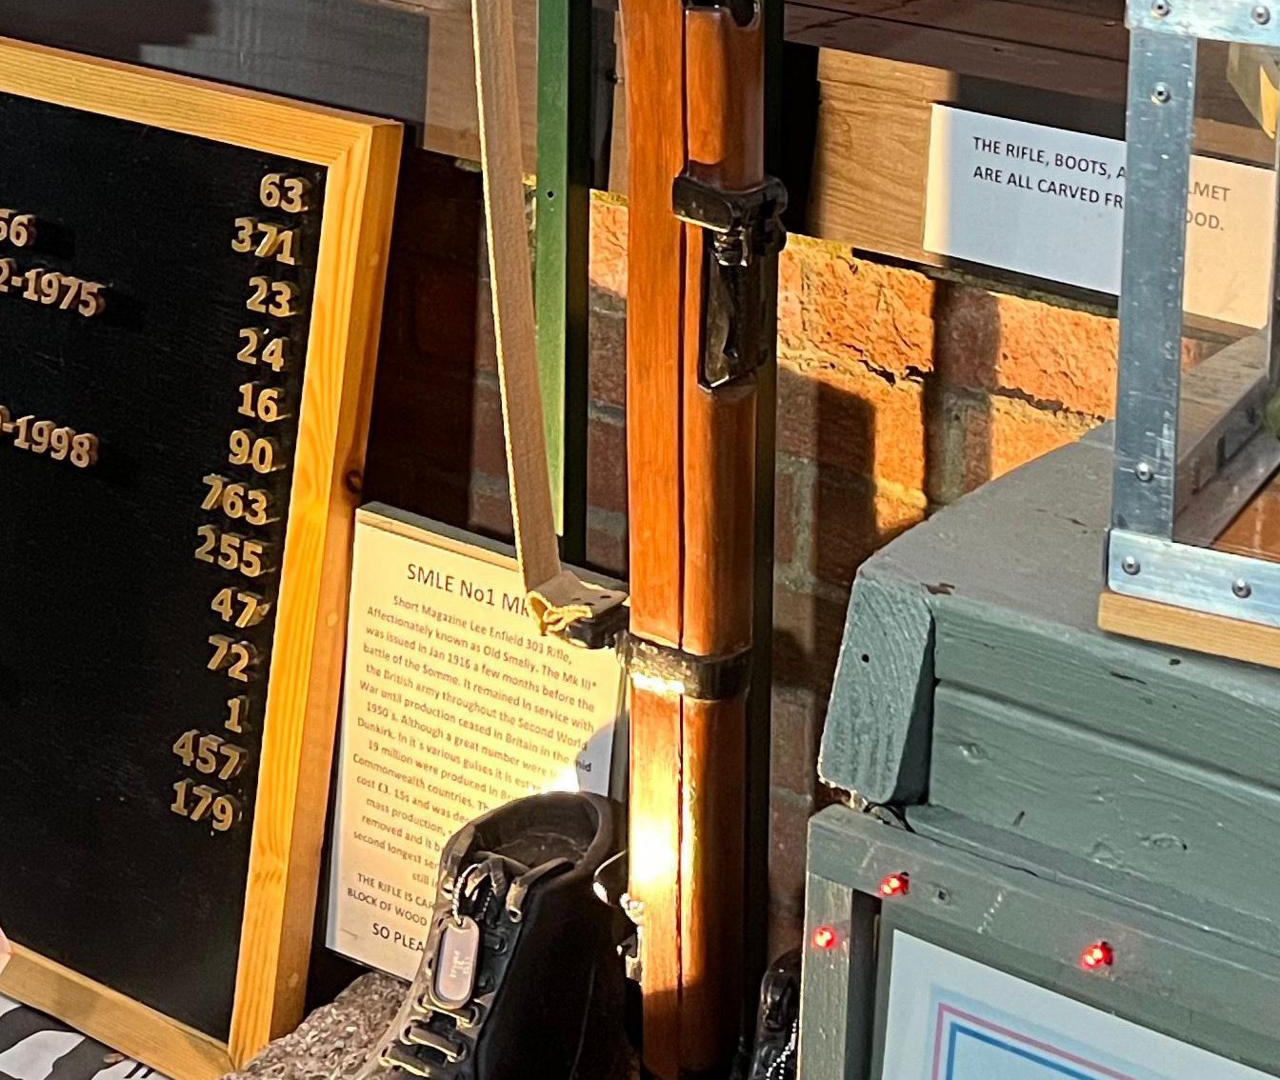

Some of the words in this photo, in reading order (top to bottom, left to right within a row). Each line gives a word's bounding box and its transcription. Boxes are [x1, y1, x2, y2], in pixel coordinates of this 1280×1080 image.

[973, 136, 1000, 155] THE
[1006, 143, 1050, 166] RIFLE,
[1054, 153, 1112, 180] BOOTS,
[259, 173, 306, 213] 63
[973, 166, 1002, 184] ARE
[1007, 174, 1033, 190] ALL
[1037, 178, 1100, 203] CARVED
[230, 216, 297, 266] 371
[246, 276, 294, 318] 23
[236, 327, 288, 372] 24
[238, 381, 280, 422] 16
[228, 429, 275, 474] 90
[200, 474, 268, 526] 763
[194, 524, 264, 578] 255
[407, 564, 454, 593] SMLE
[460, 579, 495, 606] No1
[210, 587, 261, 629] 47
[422, 604, 467, 628] Magazine
[470, 621, 486, 635] Lee
[207, 634, 255, 682] 72
[224, 696, 245, 733] 1
[172, 729, 242, 782] 457
[170, 777, 236, 832] 179
